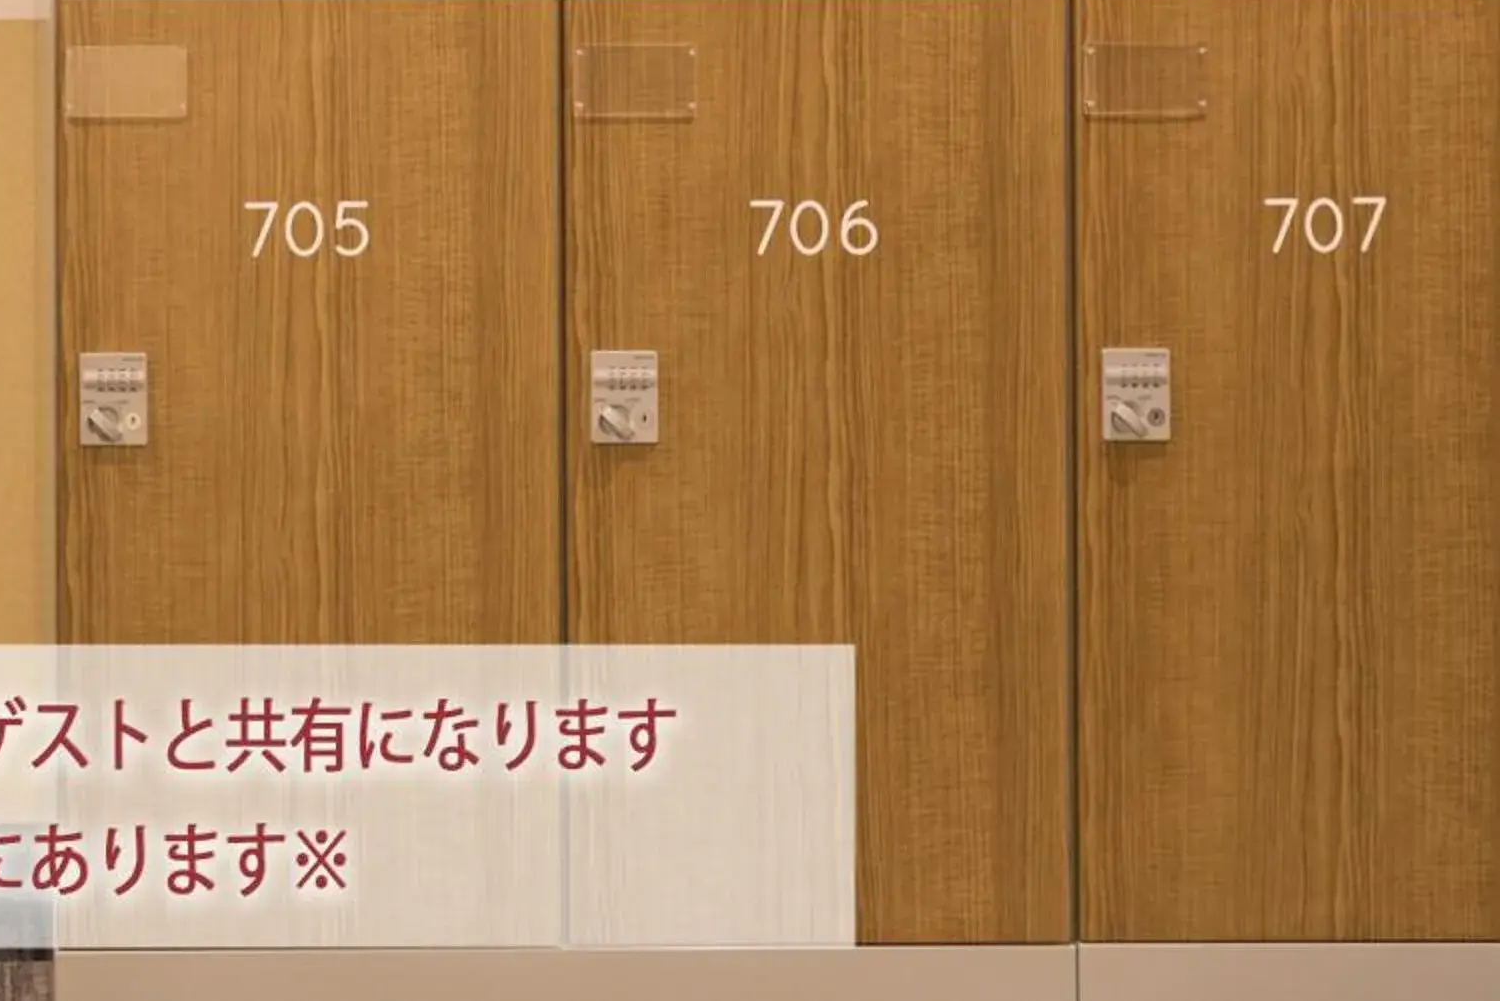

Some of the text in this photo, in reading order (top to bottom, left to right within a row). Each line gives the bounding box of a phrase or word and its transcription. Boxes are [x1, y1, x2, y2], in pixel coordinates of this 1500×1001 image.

[244, 200, 371, 259] 705
[750, 199, 880, 258] 706
[1264, 196, 1388, 255] 707
